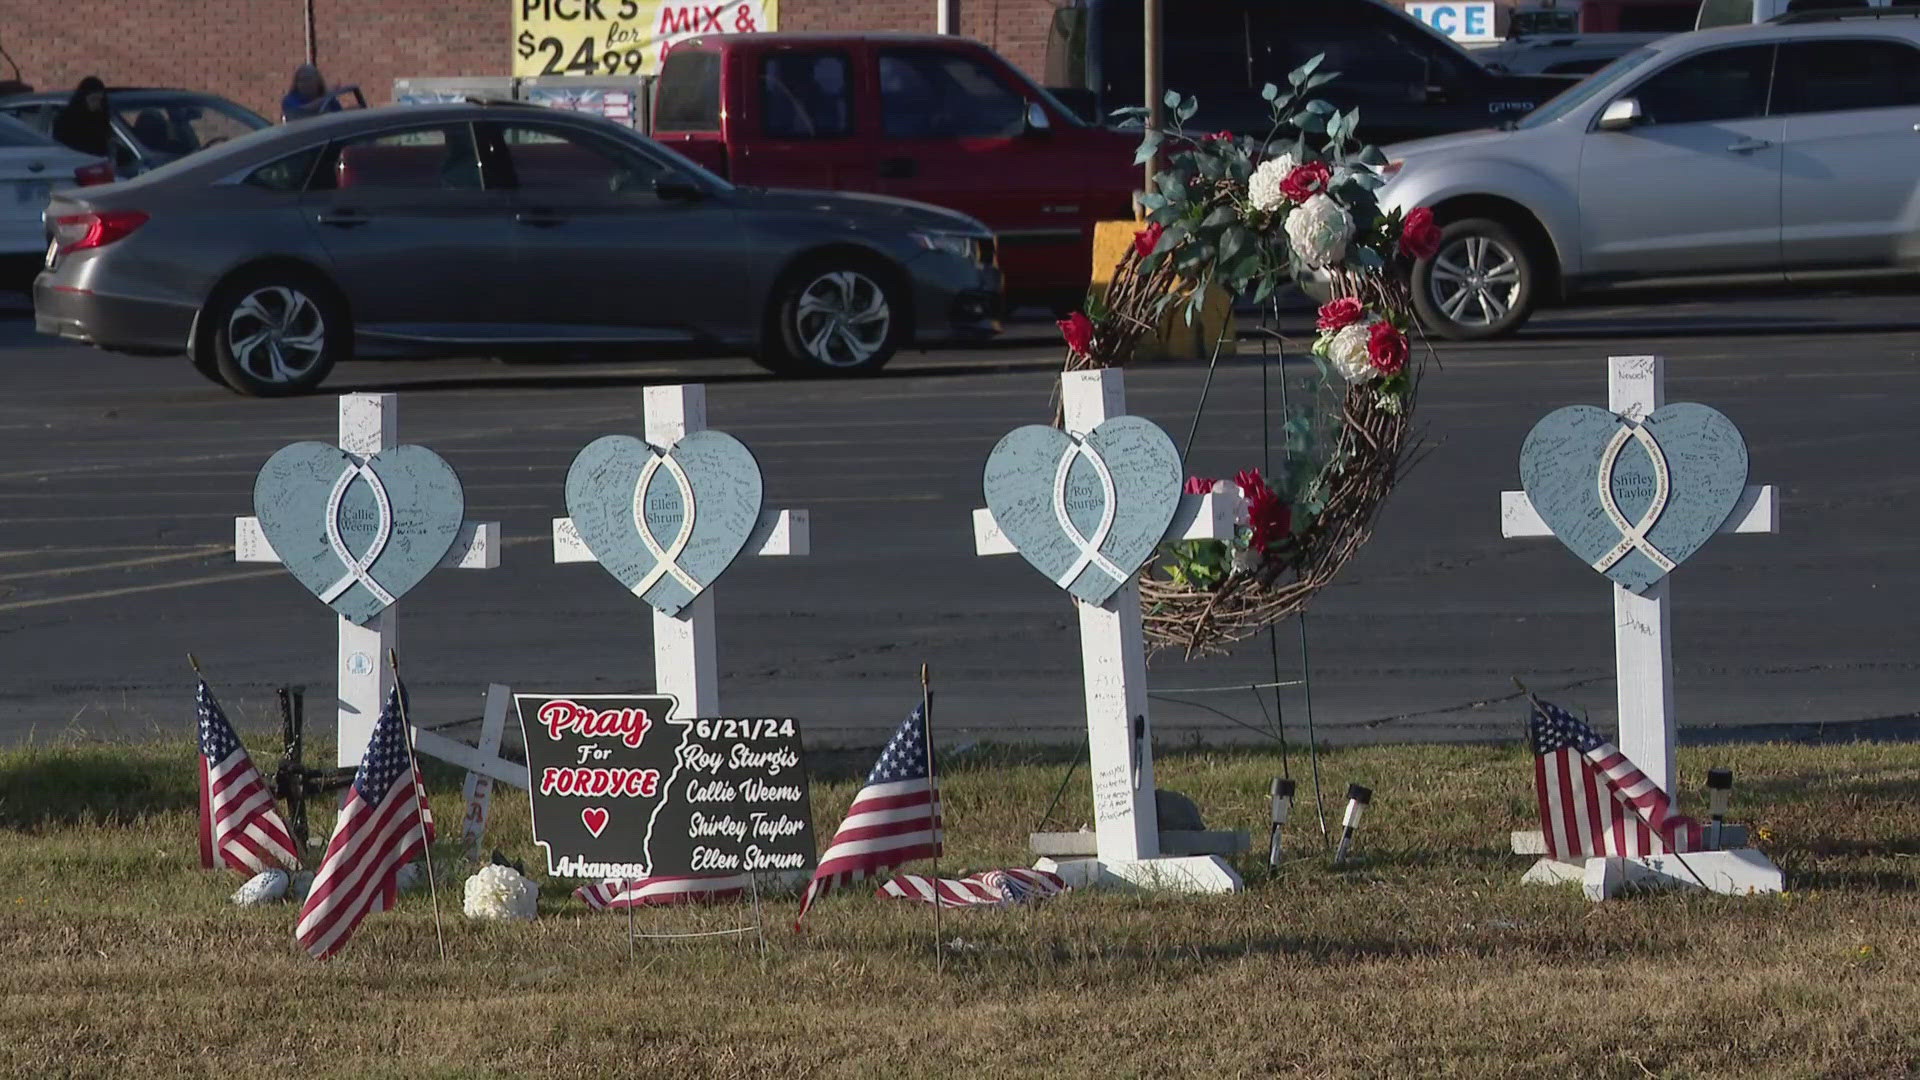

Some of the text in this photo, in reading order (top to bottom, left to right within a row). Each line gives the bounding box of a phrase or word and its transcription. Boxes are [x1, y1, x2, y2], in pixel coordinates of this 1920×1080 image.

[659, 4, 757, 34] MIX &
[606, 21, 640, 49] for
[1614, 475, 1654, 487] Shirley
[1073, 486, 1094, 498] Roy
[1616, 488, 1656, 500] Taylor
[343, 509, 375, 521] Callie
[651, 499, 678, 511] Ellen
[1067, 498, 1104, 512] Sturgis
[341, 520, 378, 532] Weems
[647, 513, 683, 525] Shrum
[537, 700, 652, 748] Pray
[696, 719, 795, 740] 6/21/24
[577, 743, 612, 764] For
[683, 743, 799, 776] Roy Sturgis
[540, 766, 660, 798] FORDYCE
[686, 777, 802, 803] Callie Weems
[689, 811, 805, 843] Shirley Taylor
[556, 854, 646, 878] Arkansas
[691, 844, 806, 871] Ellen Shrum
